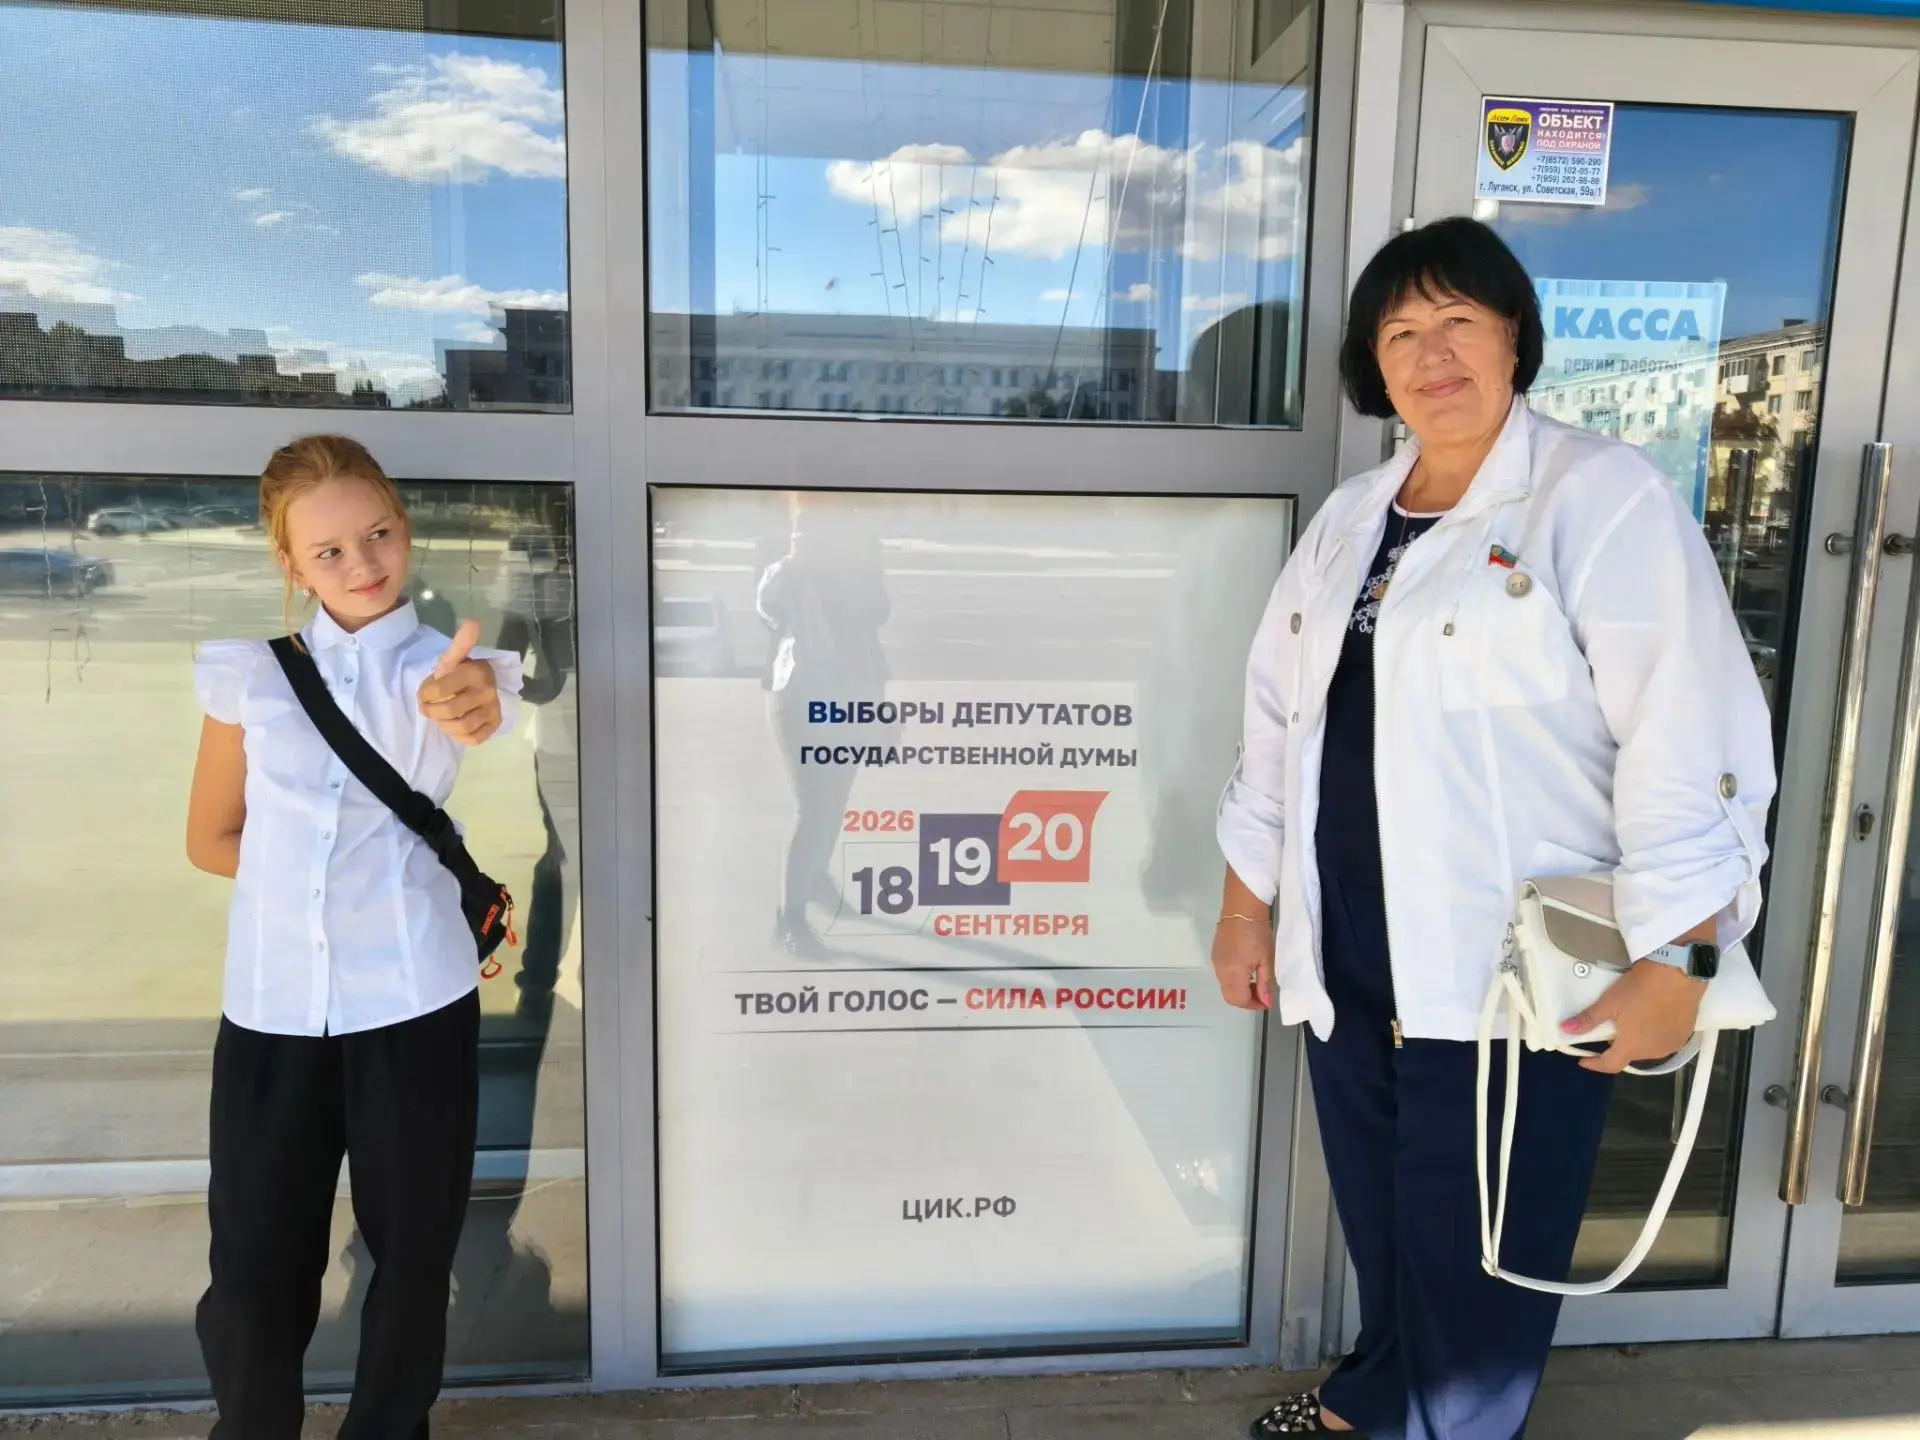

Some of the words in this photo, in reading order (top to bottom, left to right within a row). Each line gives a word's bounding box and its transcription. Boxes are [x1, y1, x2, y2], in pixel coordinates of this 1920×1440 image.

[1538, 113, 1604, 129] ОБЪЕКТ
[1536, 139, 1556, 148] ПОД
[1558, 140, 1601, 150] ОХРАНОЙ
[1537, 129, 1602, 141] НАХОДИТСЯ
[1532, 165, 1561, 174] +7(959)
[1563, 167, 1601, 175] 102-05-77
[1570, 157, 1602, 166] 590-290
[1488, 181, 1520, 195] Луганск,
[1522, 185, 1534, 195] ул.
[1536, 183, 1578, 197] Советская,
[1531, 174, 1560, 184] +7(959)
[1553, 306, 1701, 341] КАССА
[1564, 358, 1615, 374] режим
[807, 700, 944, 726] ВЫБОРЫ
[951, 702, 1133, 729] ДЕПУТАТОВ
[800, 742, 1054, 768] ГОСУДАРСТВЕННОЙ
[1059, 748, 1137, 769] ДУМЫ
[843, 810, 915, 832] 2026
[1007, 812, 1084, 862] 20
[928, 837, 992, 887] 19
[851, 866, 915, 916] 18
[933, 914, 1090, 937] СЕНТЯБРЯ
[734, 985, 819, 1015] ТВОЙ
[828, 989, 930, 1013] ГОЛОС
[964, 987, 1048, 1011] СИЛА
[1055, 986, 1187, 1011] РОССИИ!
[902, 1195, 1017, 1223] ЦИК.РФ
